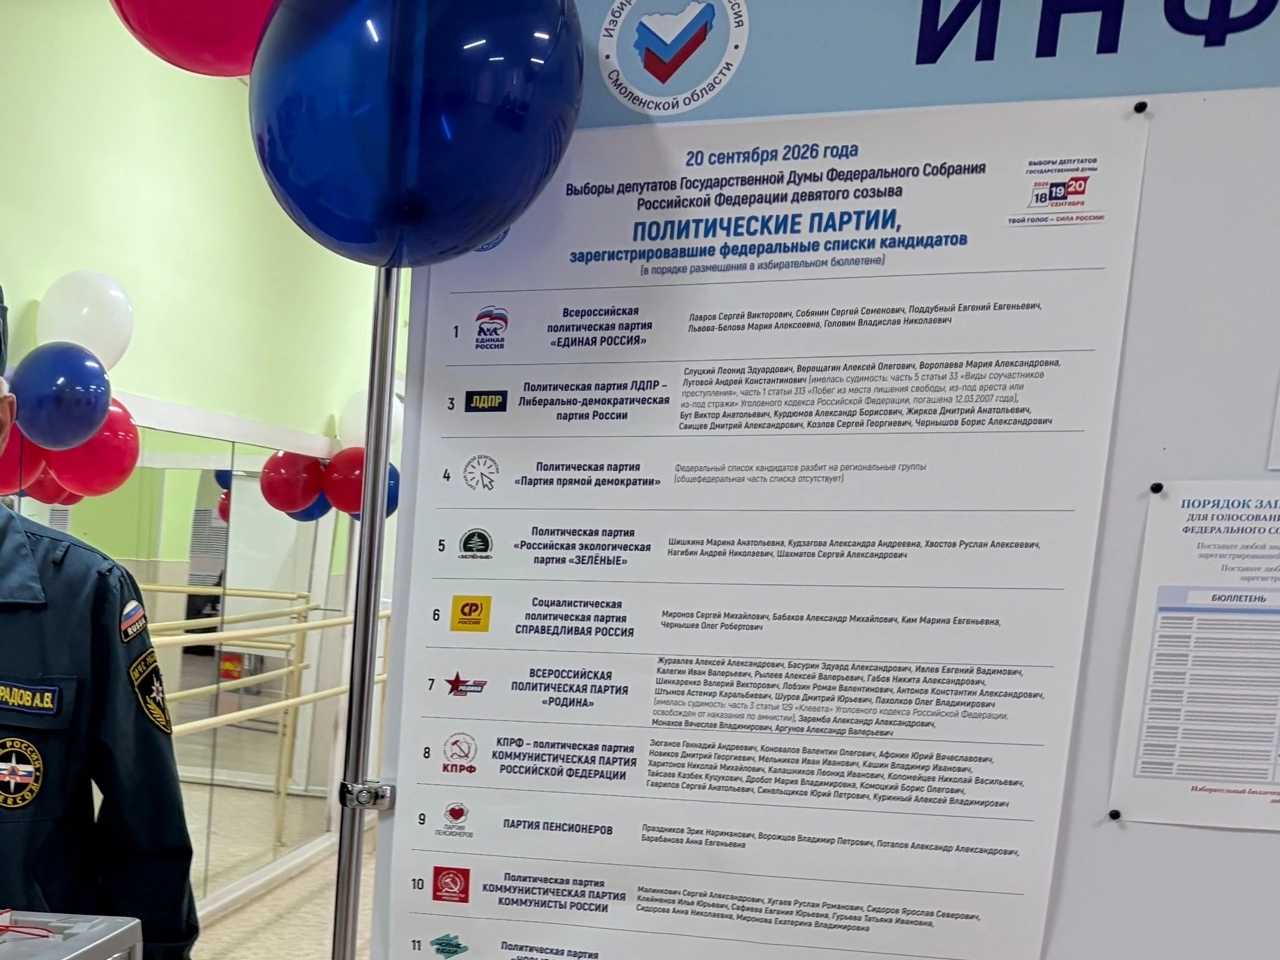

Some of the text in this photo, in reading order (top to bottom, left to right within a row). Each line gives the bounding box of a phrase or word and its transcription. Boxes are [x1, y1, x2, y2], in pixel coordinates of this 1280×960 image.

[607, 61, 734, 111] Смоленской области
[684, 143, 859, 167] 20 сентября 2026 года
[565, 159, 986, 198] Выборы депутатов Государственной Думы Федерального Собрания
[636, 185, 903, 210] Российской Федерации девятого созыва
[1034, 180, 1085, 203] 18 19 20
[632, 208, 902, 241] ПОЛИТИЧЕСКИЕ ПАРТИИ,
[568, 233, 968, 265] зарегистрировавшие федеральные списки кандидатов
[639, 253, 886, 275] (в порядке размещения в избирательном бюллетене)
[562, 305, 639, 317] Всероссийская
[453, 325, 458, 338] 1
[546, 321, 652, 332] политическая партия
[549, 334, 647, 348] «ЕДИНАЯ РОССИЯ»
[522, 380, 660, 392] Политическая партия ЛДПР
[447, 397, 455, 410] 3
[470, 395, 502, 408] ЛДПР
[517, 395, 670, 407] Либерально-демократическая
[555, 409, 628, 422] партия России
[535, 461, 640, 473] Политическая партия
[443, 469, 451, 481] 4
[514, 475, 661, 487] «Партия прямой демократии»
[1181, 499, 1252, 510] ПОРЯДОК
[1186, 513, 1209, 522] ДЛЯ
[530, 526, 635, 539] Политическая партия
[1182, 526, 1267, 535] ФЕДЕРАЛЬНОГО
[438, 539, 445, 551] 5
[512, 540, 651, 551] «Российская экологическая
[532, 555, 628, 566] партия «ЗЕЛЁНЫЕ»
[531, 597, 622, 609] Социалистическая
[1211, 594, 1267, 603] БЮЛЛЕТЕНЬ
[432, 609, 440, 621] 6
[524, 612, 627, 624] политическая партия
[660, 610, 1002, 626] Миронов Сергей Михайлович, Бабаков Александр Михайлович, Ким Марина Евгеньевна,
[514, 624, 634, 637] СПРАВЕДЛИВАЯ РОССИЯ
[528, 668, 612, 680] ВСЕРОССИЙСКАЯ
[428, 678, 435, 691] 7
[510, 681, 628, 695] ПОЛИТИЧЕСКАЯ ПАРТИЯ
[33, 692, 54, 709] А.В.
[541, 696, 594, 708] «РОДИНА»
[495, 736, 635, 755] КПРФ политическая партия
[6, 741, 41, 769] РОССИИ
[423, 746, 430, 759] 8
[491, 750, 637, 767] КОММУНИСТИЧЕСКАЯ ПАРТИЯ
[442, 763, 476, 774] КПРФ
[498, 762, 626, 781] РОССИЙСКОЙ ФЕДЕРАЦИИ
[418, 813, 426, 825] 9
[502, 818, 613, 835] ПАРТИЯ ПЕНСИОНЕРОВ
[412, 878, 424, 890] 10
[503, 872, 605, 889] Политическая партия
[481, 883, 626, 901] КОММУНИСТИЧЕСКАЯ ПАРТИЯ
[497, 896, 608, 912] КОММУНИСТЫ РОССИИ
[411, 940, 421, 951] 11
[500, 940, 599, 960] Политическая партия
